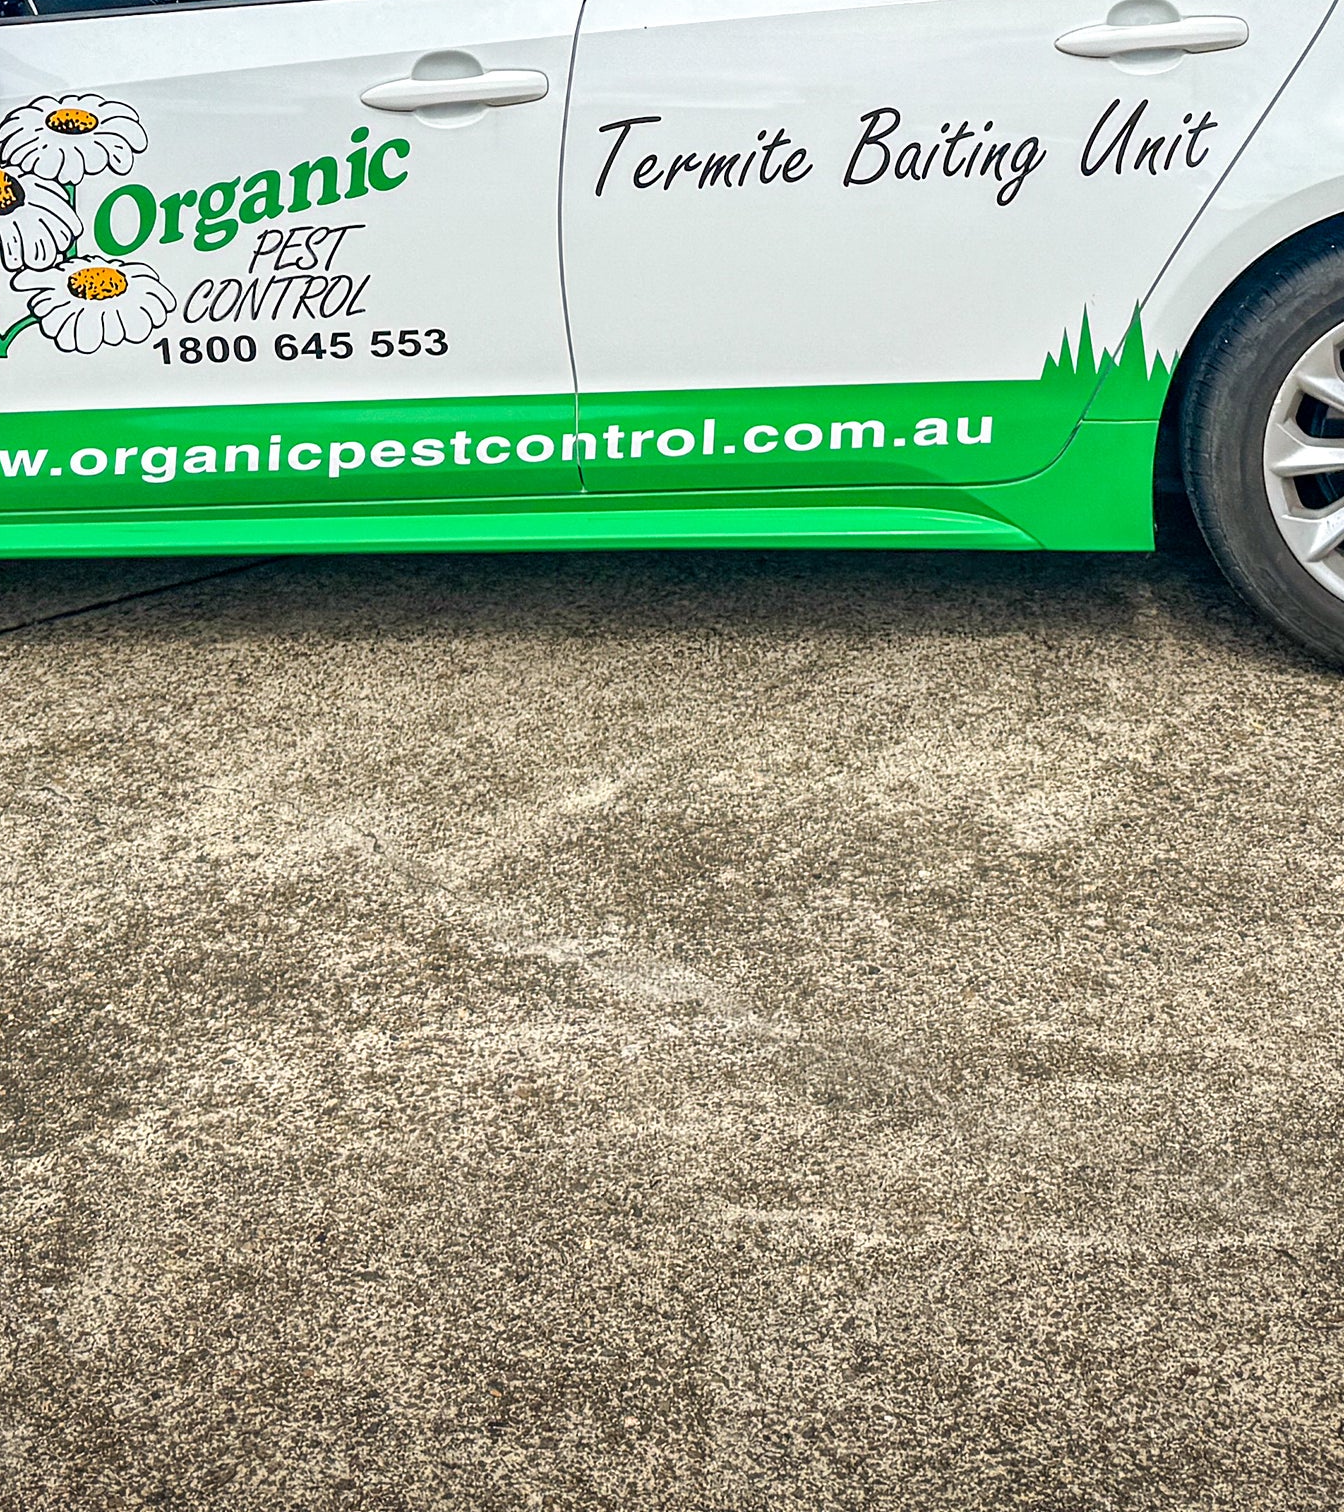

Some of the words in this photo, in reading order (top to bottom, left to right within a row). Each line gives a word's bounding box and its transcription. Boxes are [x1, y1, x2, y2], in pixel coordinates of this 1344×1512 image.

[595, 114, 814, 198] Termite
[843, 107, 1047, 206] Baiting
[1080, 98, 1218, 178] Unit
[93, 126, 411, 257] Organic
[248, 224, 366, 274] PEST
[182, 273, 371, 324] CONTROL
[154, 334, 257, 365] 1800
[273, 332, 354, 362] 645
[369, 328, 449, 358] 553
